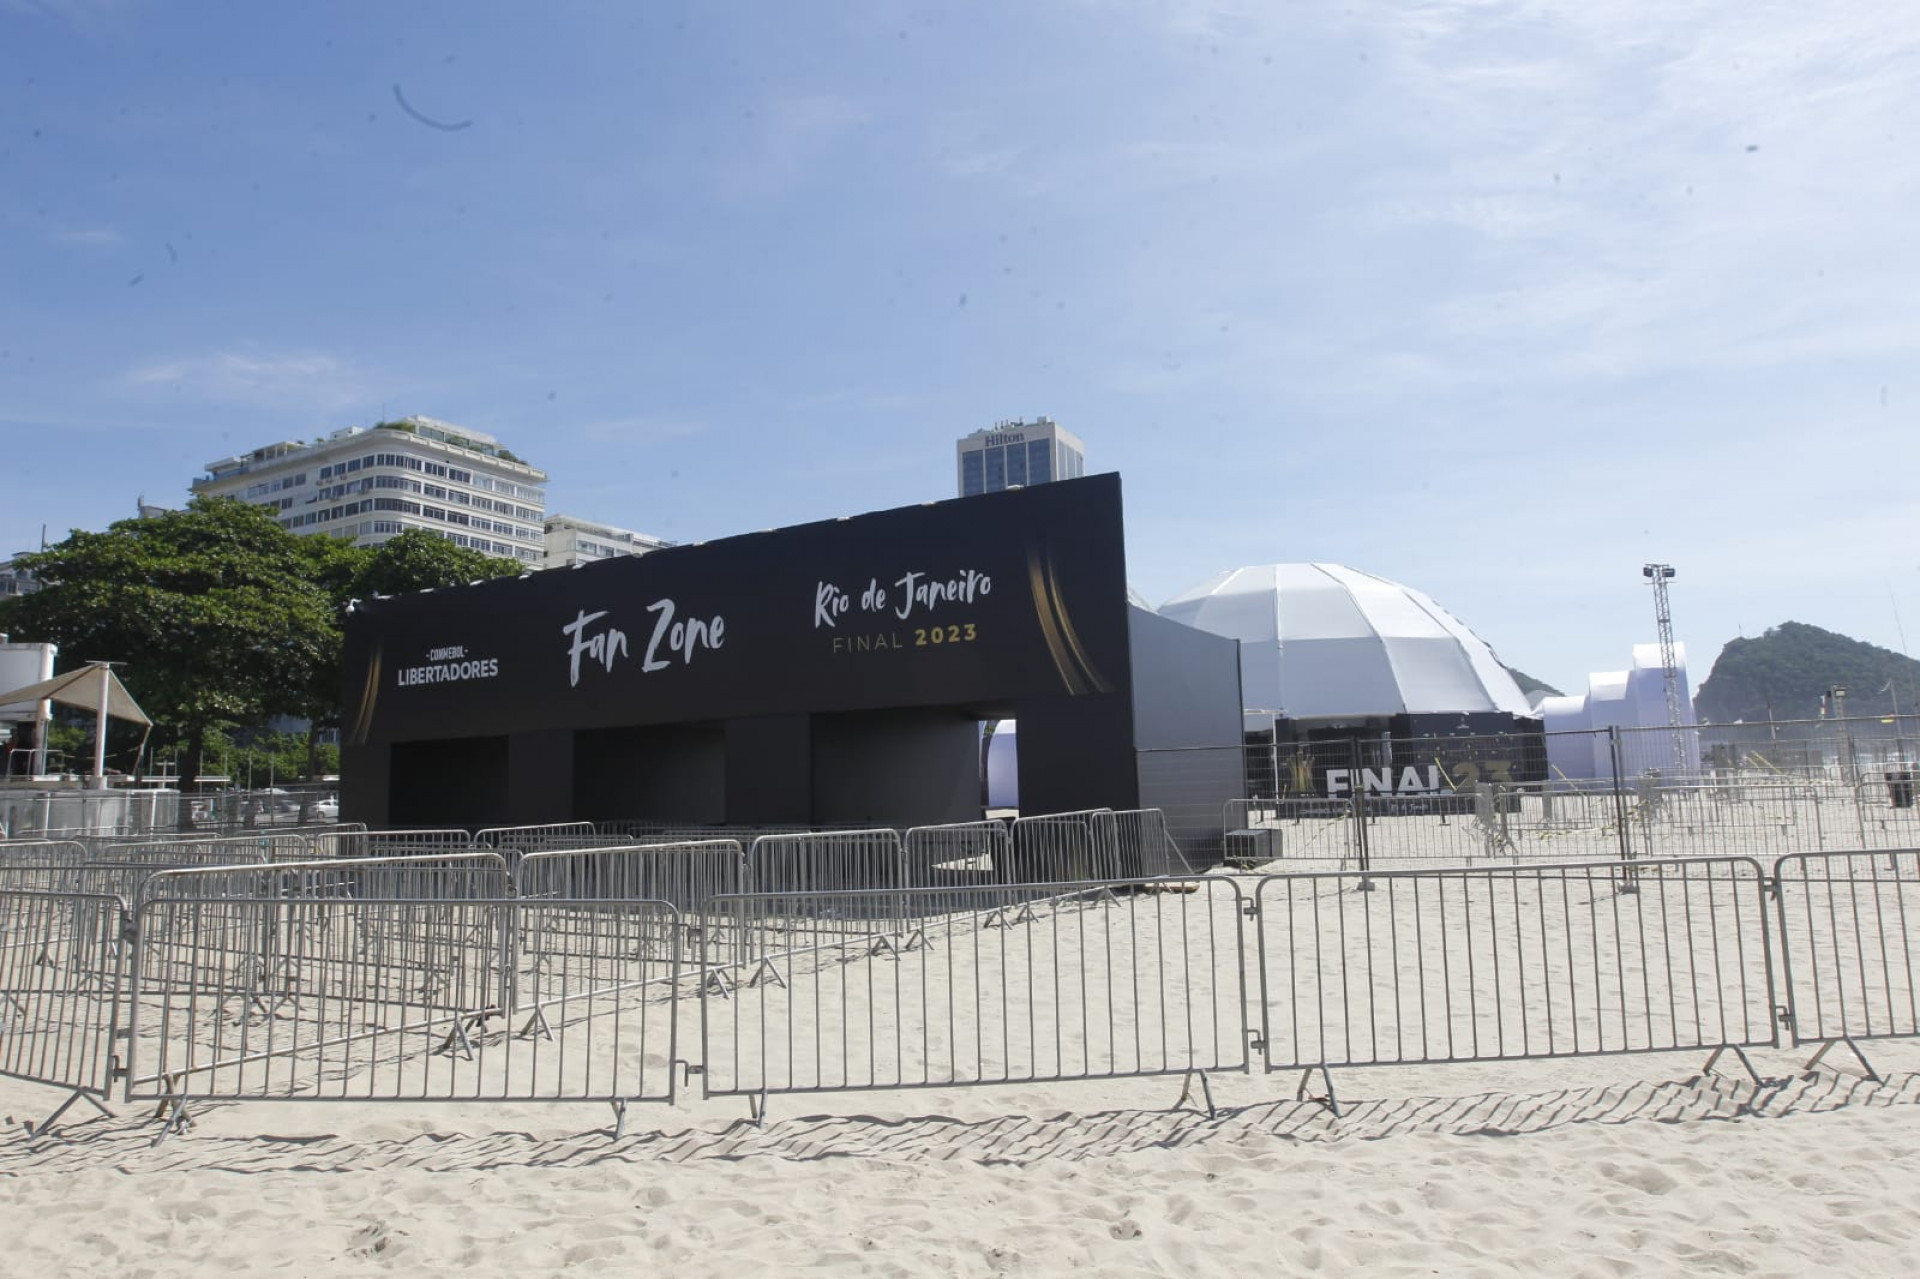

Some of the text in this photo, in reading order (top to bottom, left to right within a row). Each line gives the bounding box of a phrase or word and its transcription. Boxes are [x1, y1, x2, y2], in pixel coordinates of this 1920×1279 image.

[985, 432, 1024, 447] Hilton
[815, 569, 992, 628] Rio de Janeiro
[563, 598, 725, 688] Fan Zone
[833, 623, 977, 654] FINAL 2023
[398, 658, 499, 687] LIBERTADORES
